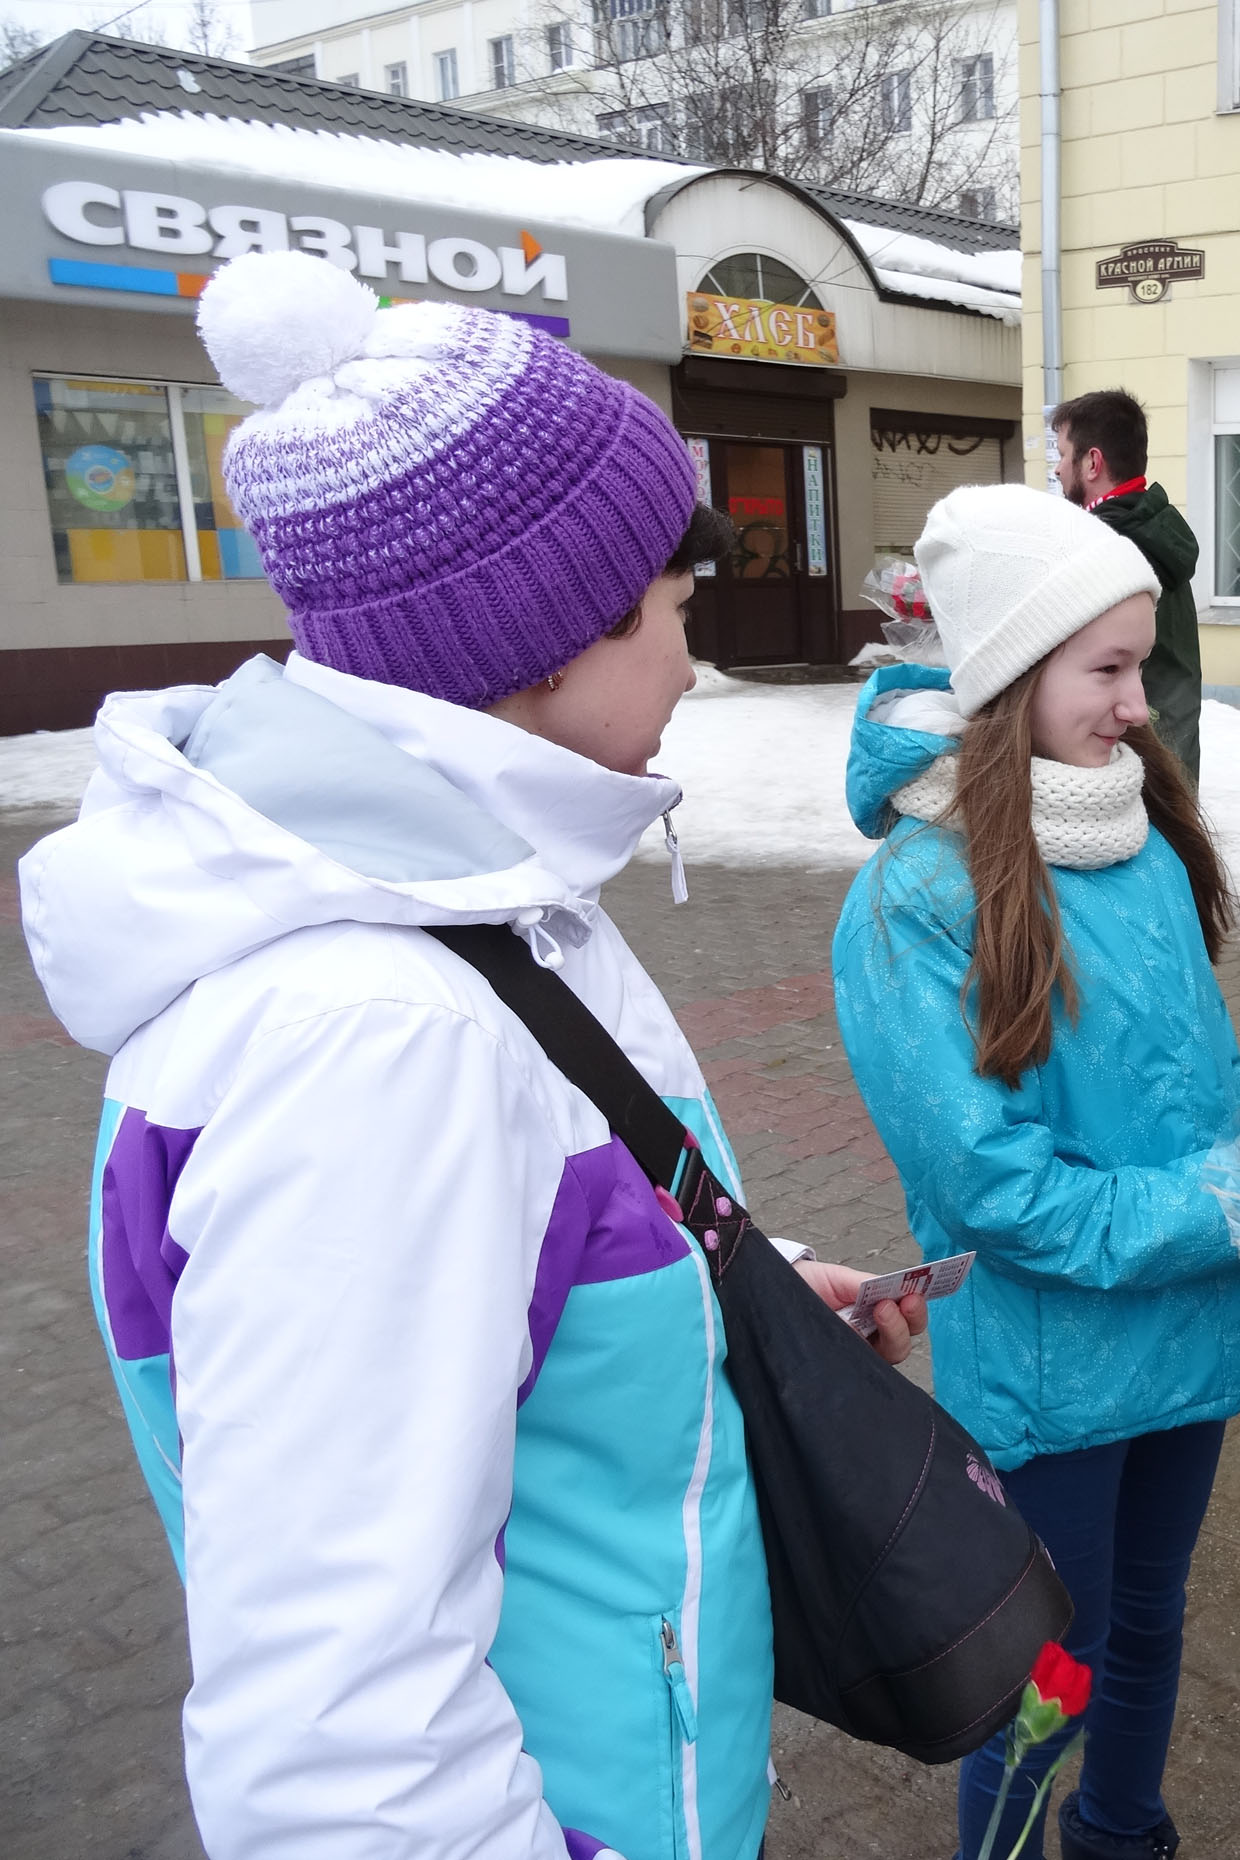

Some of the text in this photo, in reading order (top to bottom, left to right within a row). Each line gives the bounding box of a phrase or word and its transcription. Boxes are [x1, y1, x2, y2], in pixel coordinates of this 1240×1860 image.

[42, 181, 567, 301] СВЯЗНОЙ
[1100, 255, 1200, 276] КРАСНОЙ АРМИИ
[1140, 283, 1158, 296] 182
[714, 302, 816, 349] ХЛЕБ
[807, 459, 822, 561] НАПИТКИ
